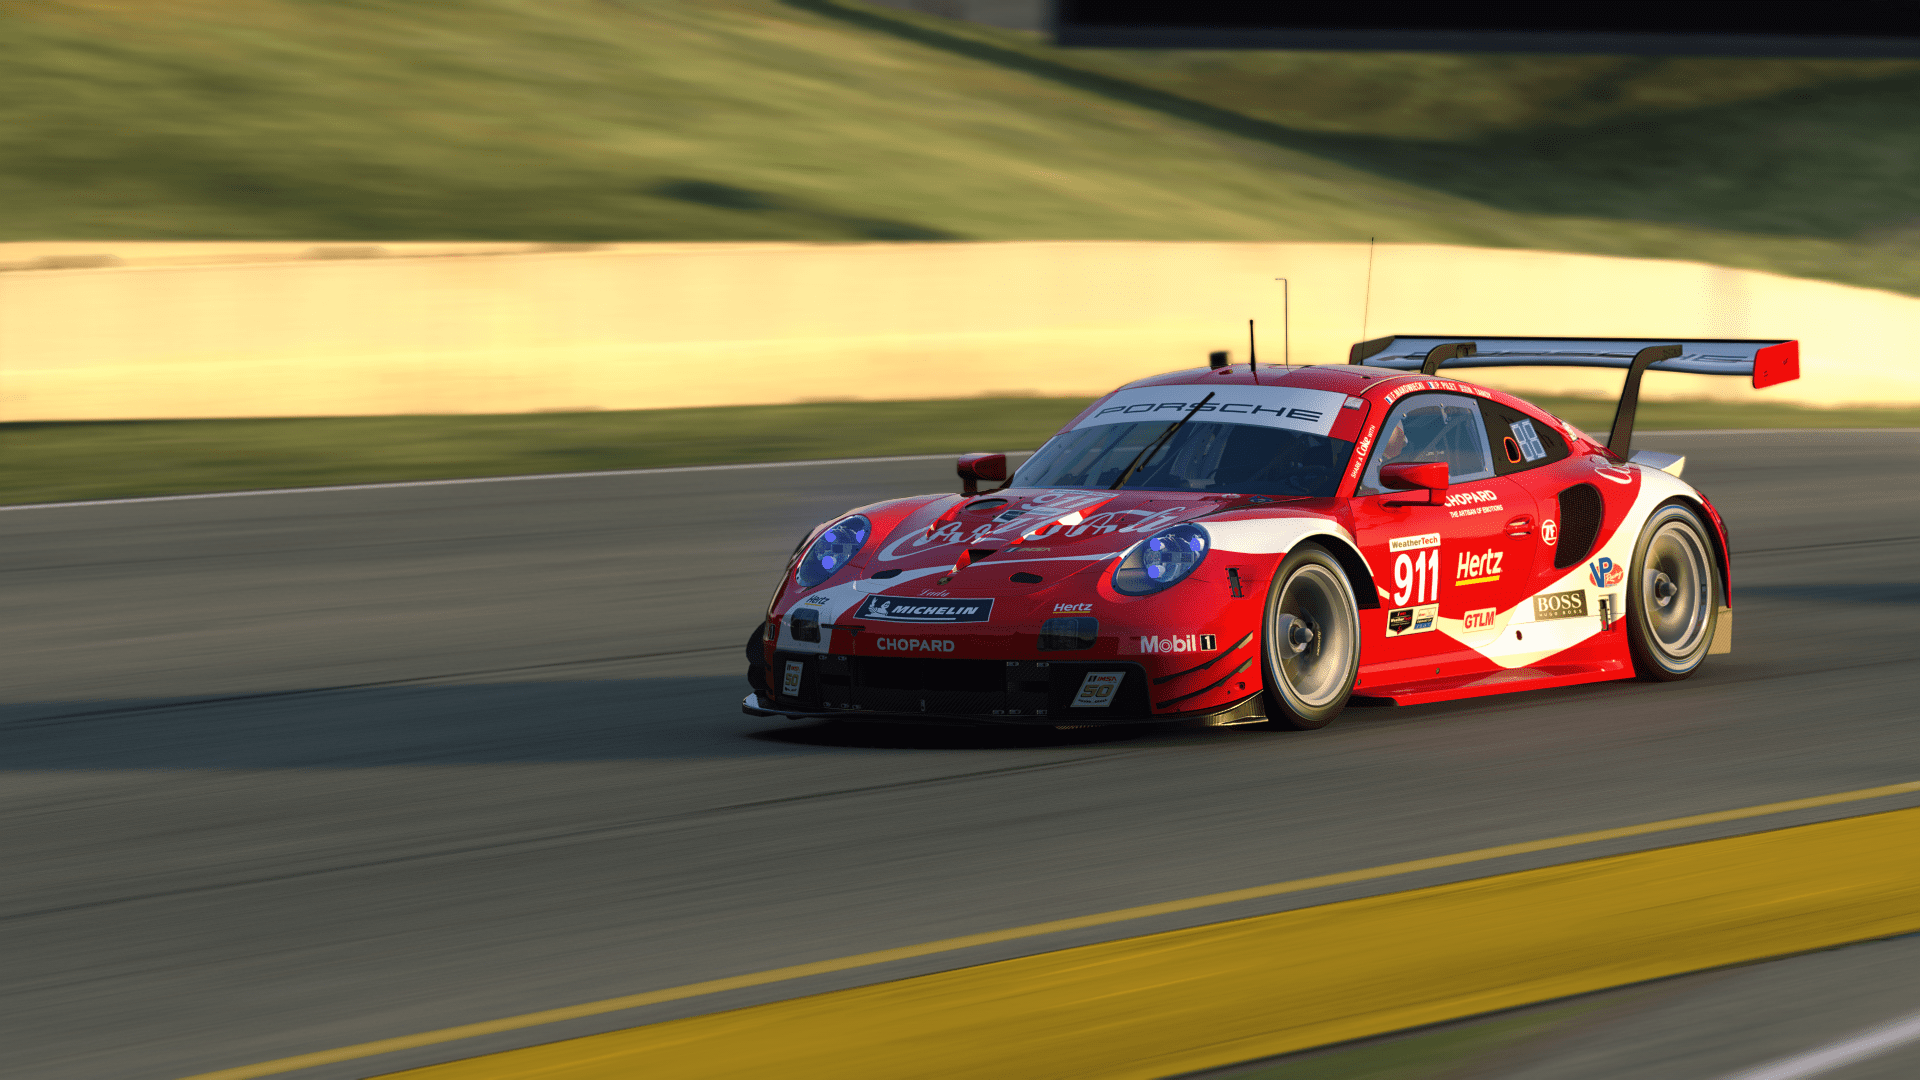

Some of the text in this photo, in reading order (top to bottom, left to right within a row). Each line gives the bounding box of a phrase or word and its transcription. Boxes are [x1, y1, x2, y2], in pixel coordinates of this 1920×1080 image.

[1094, 402, 1323, 423] PORSCHE
[1356, 436, 1371, 456] Coke
[1391, 536, 1438, 549] WeatherTech
[1456, 548, 1503, 579] Hertz
[1589, 557, 1613, 588] VP
[1393, 549, 1439, 606] 911
[807, 595, 830, 605] Hertz
[1053, 603, 1093, 612] Hertz
[1538, 593, 1582, 612] BOSS
[891, 605, 979, 615] MICHELIN
[1465, 611, 1494, 629] GTLM
[876, 637, 955, 652] CHOPARD
[1140, 634, 1196, 653] Mobil
[785, 673, 799, 687] 50
[1080, 684, 1115, 698] 50
